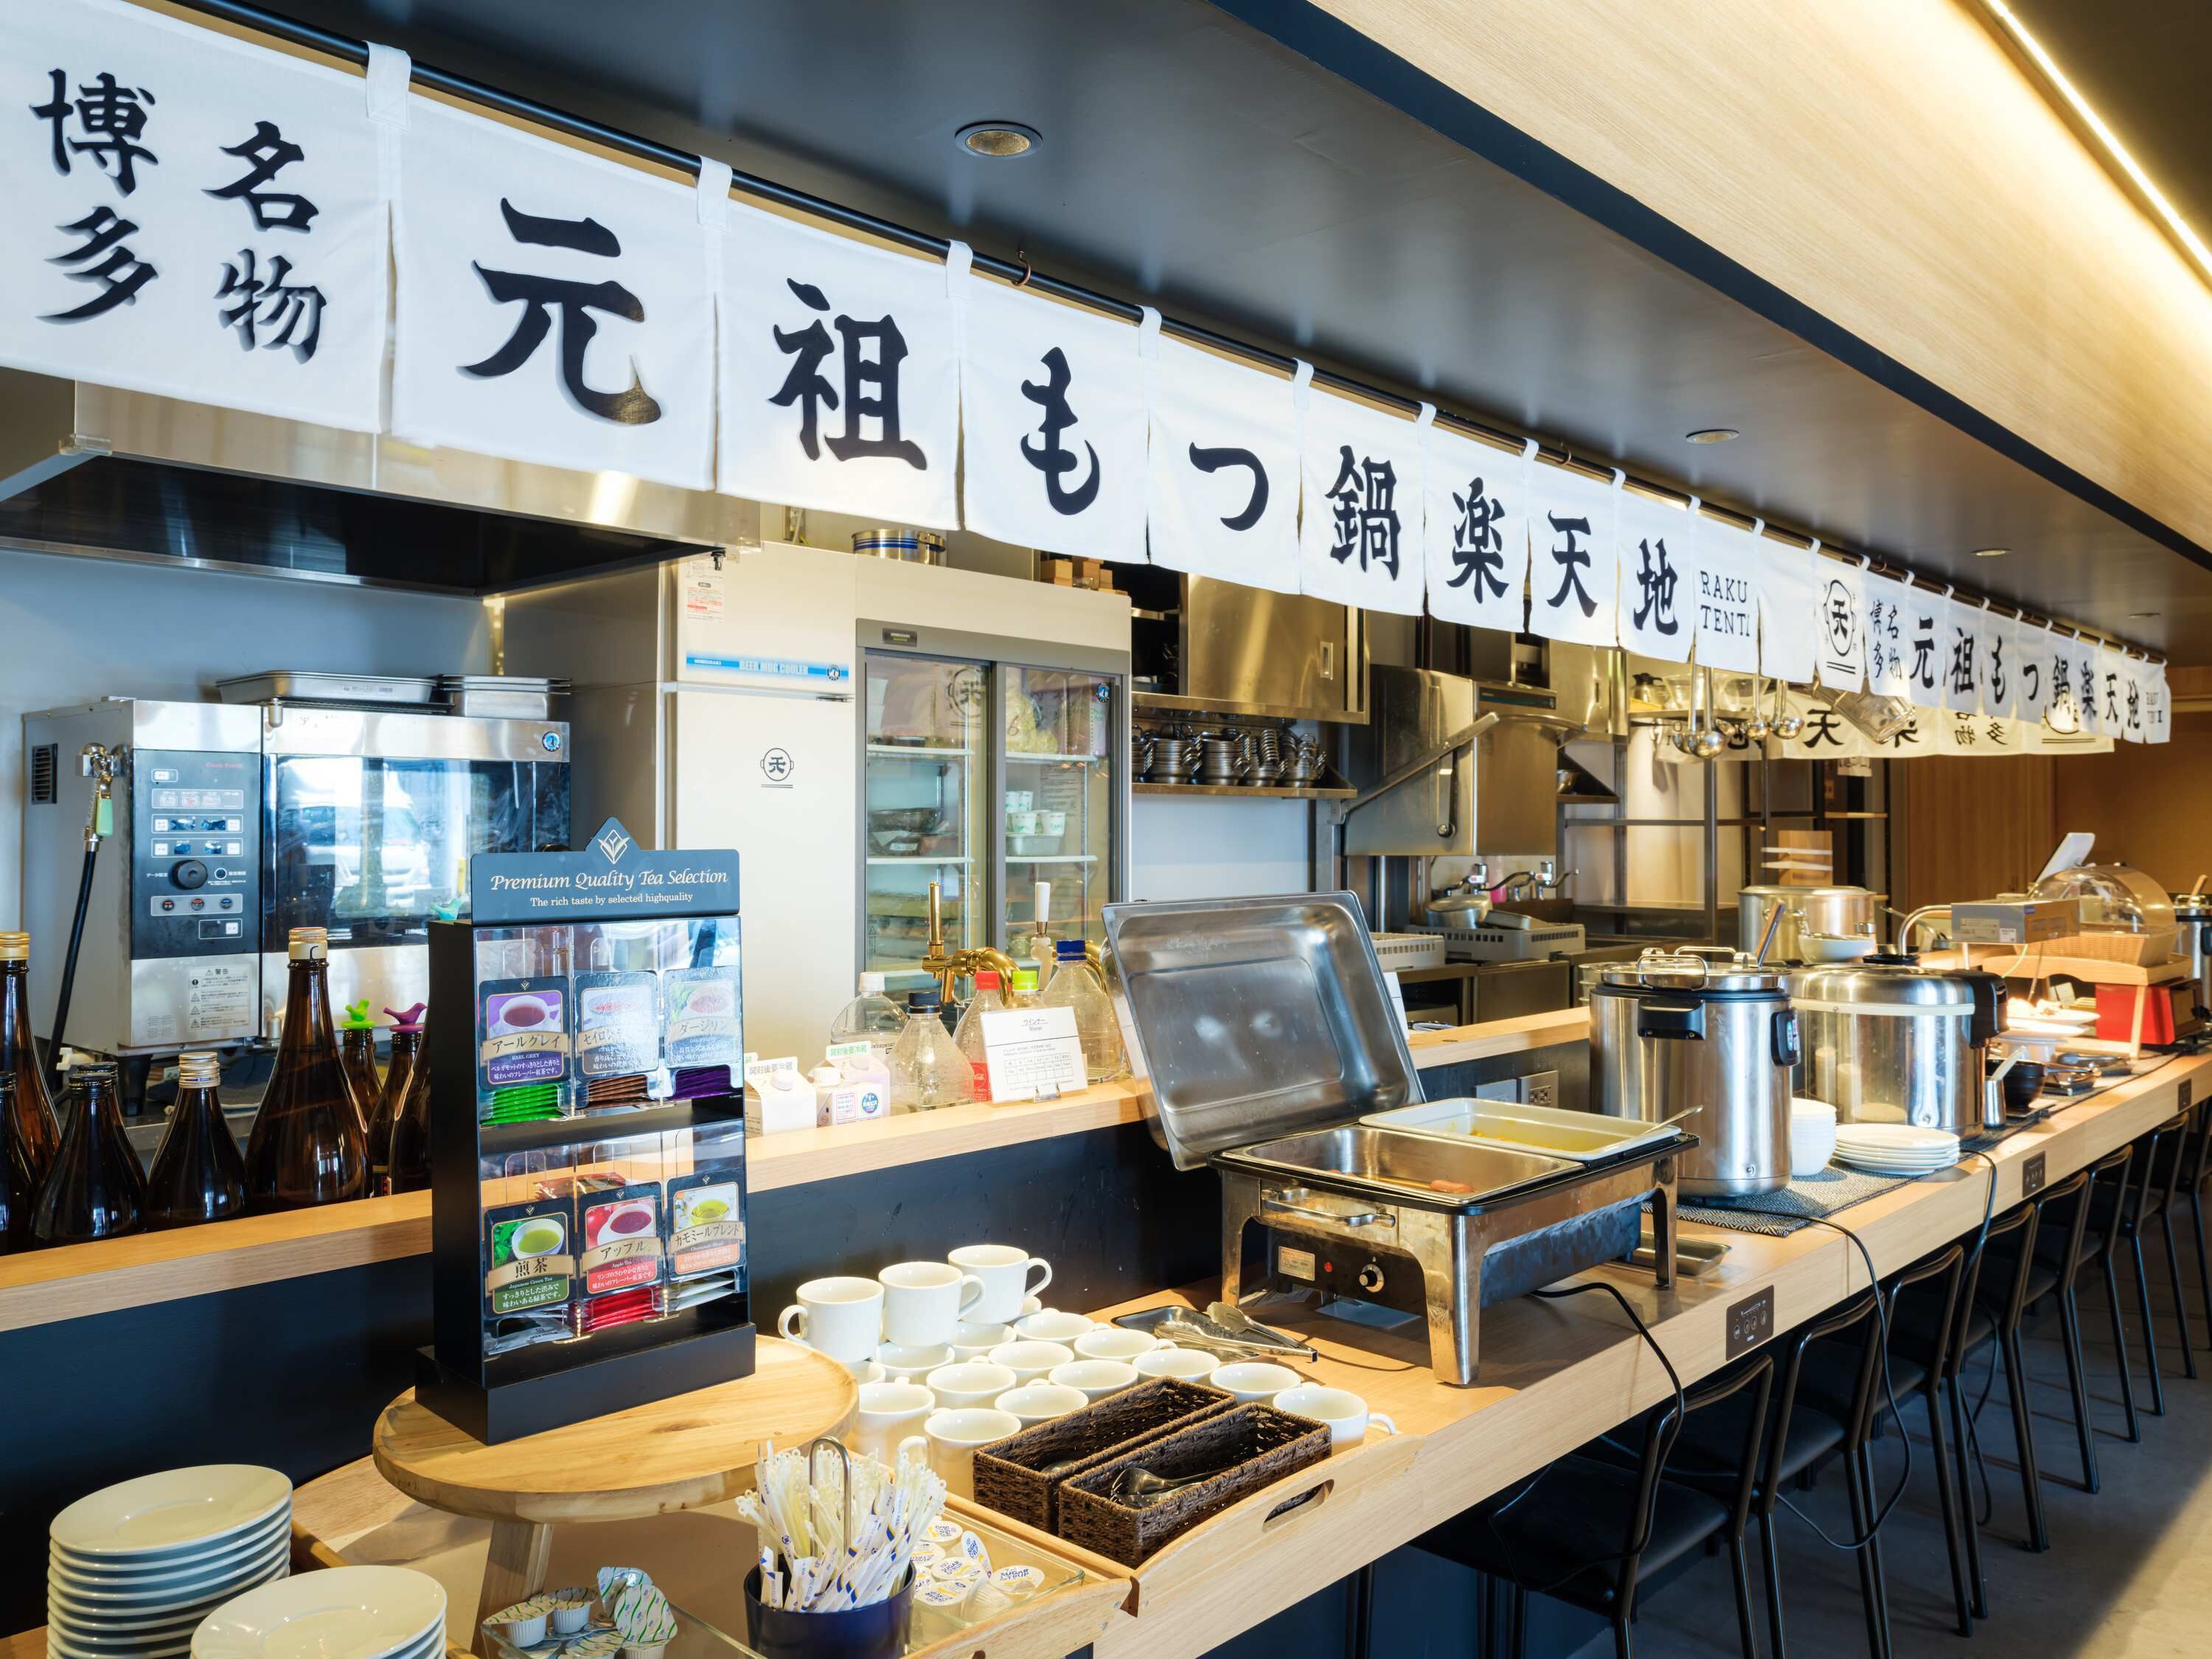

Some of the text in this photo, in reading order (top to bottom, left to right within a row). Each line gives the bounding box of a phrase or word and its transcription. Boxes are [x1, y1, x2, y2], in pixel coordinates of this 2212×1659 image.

[31, 69, 159, 324] 博多
[201, 121, 327, 365] 名物
[1700, 571, 1748, 603] RAKU
[1700, 605, 1750, 637] TENTI
[490, 869, 728, 891] Premium Quality Tea Selection
[530, 892, 693, 907] The rich taste by selected highquality
[493, 1035, 560, 1054] アールグレイ
[675, 1223, 741, 1246] カモミールブレンド
[515, 1258, 548, 1278] 煎茶
[502, 1283, 560, 1300] すっきりとした渋みで
